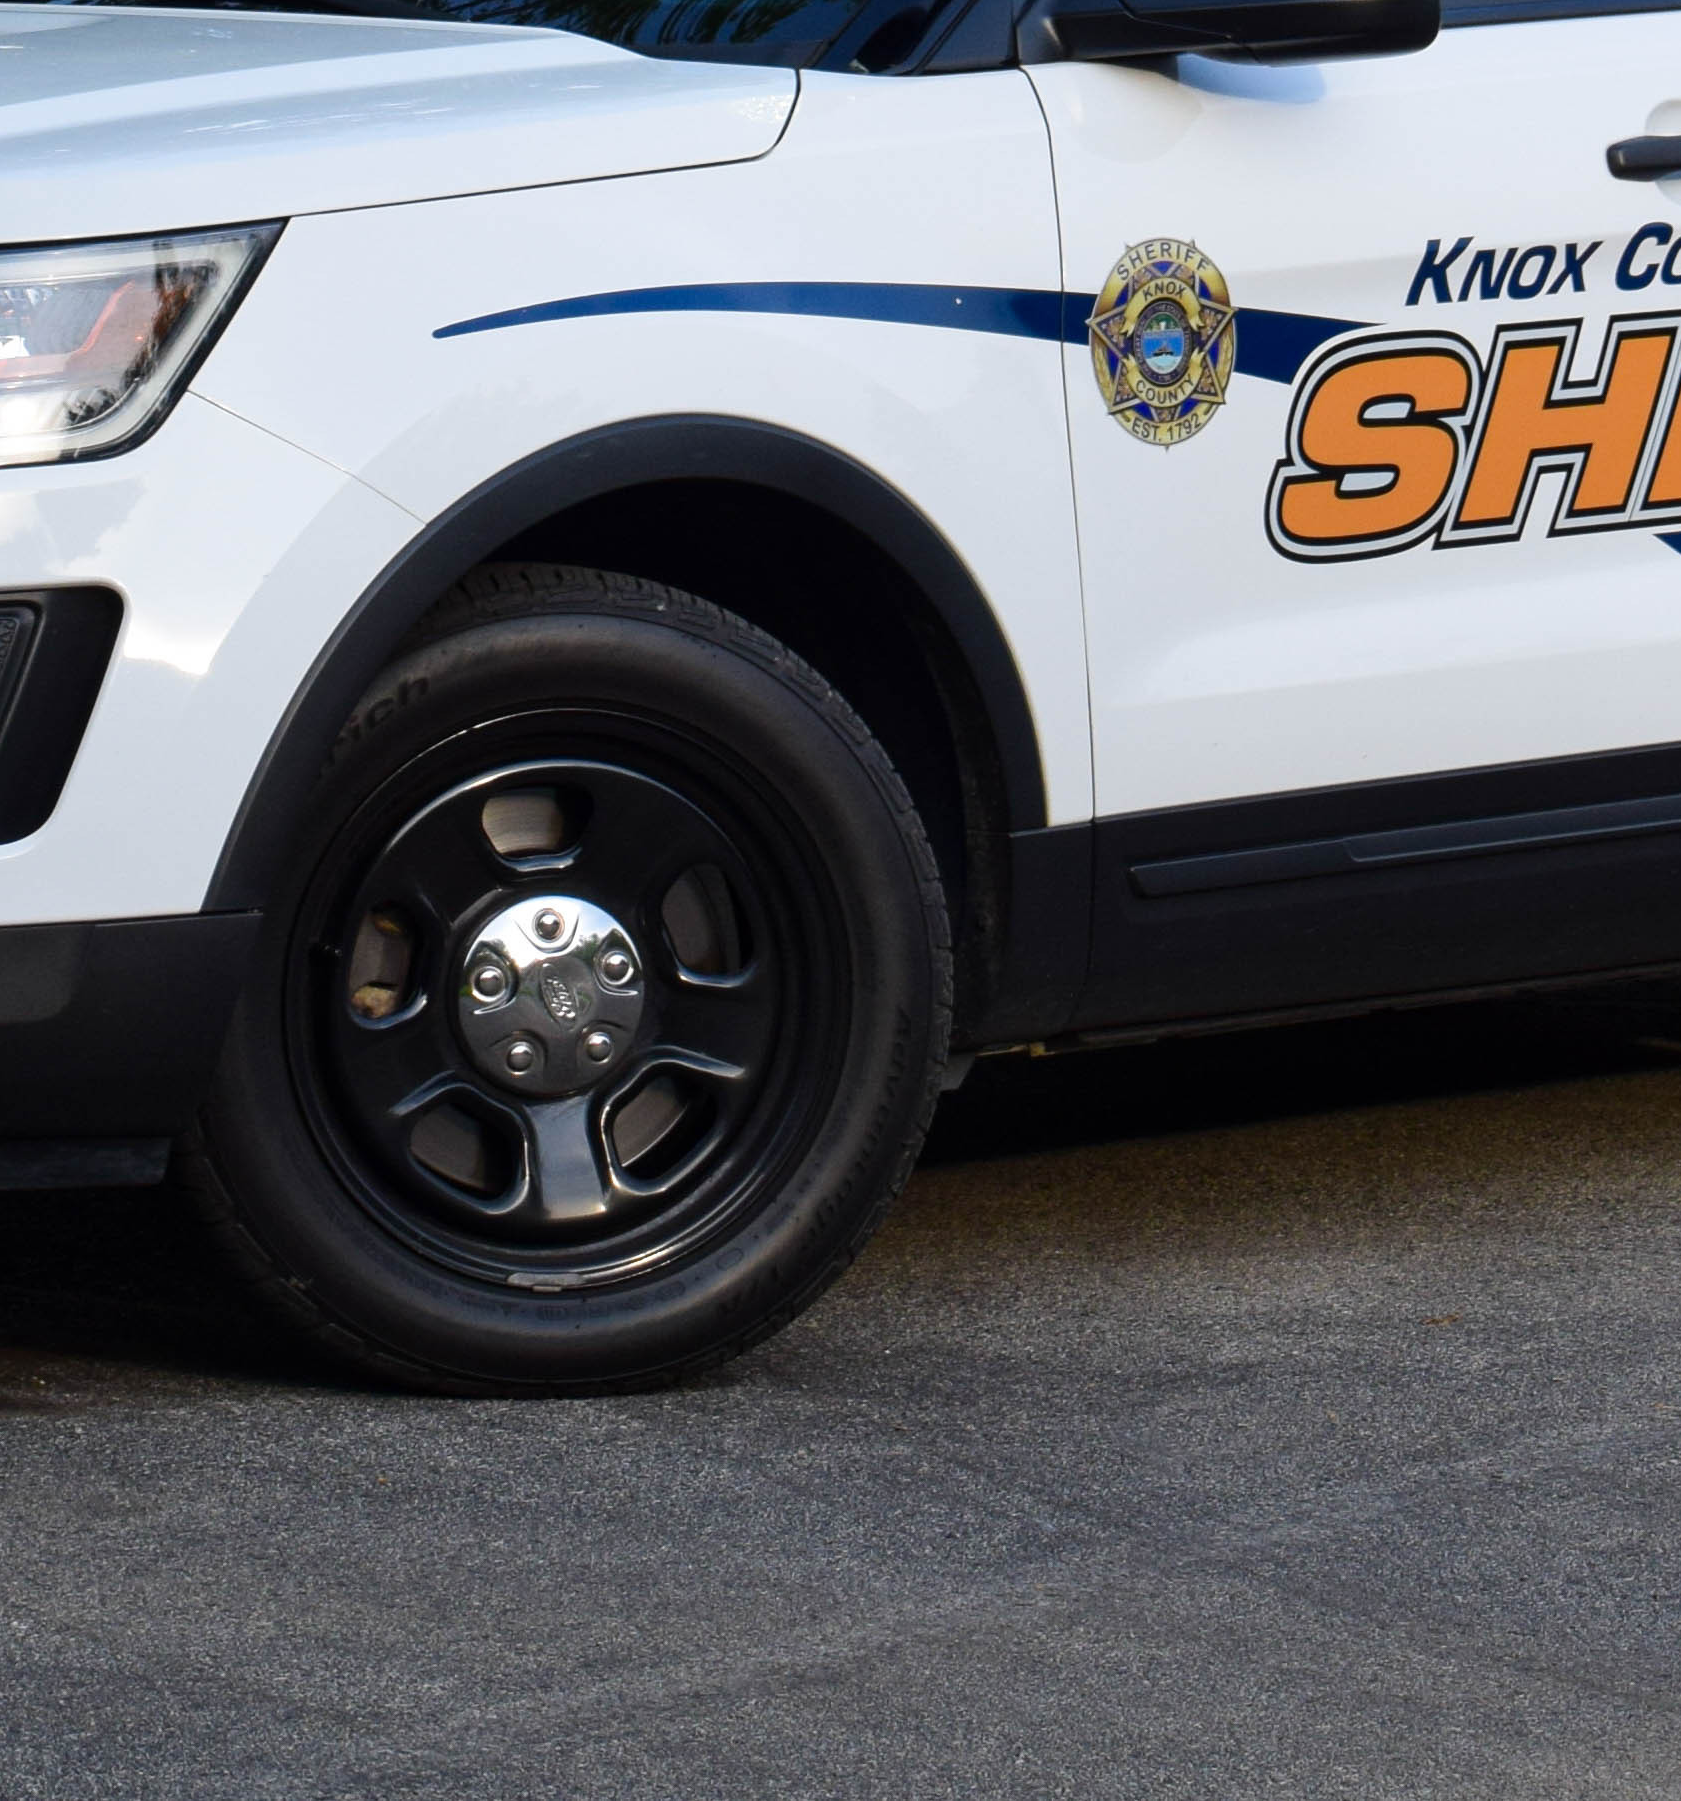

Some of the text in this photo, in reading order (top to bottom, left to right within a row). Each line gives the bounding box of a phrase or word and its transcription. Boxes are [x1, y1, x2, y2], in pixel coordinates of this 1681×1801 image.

[1116, 241, 1212, 281] SHERIFF
[1142, 281, 1187, 302] KNOX
[1135, 375, 1195, 405] COUNTY
[1131, 412, 1203, 443] EST. 1792
